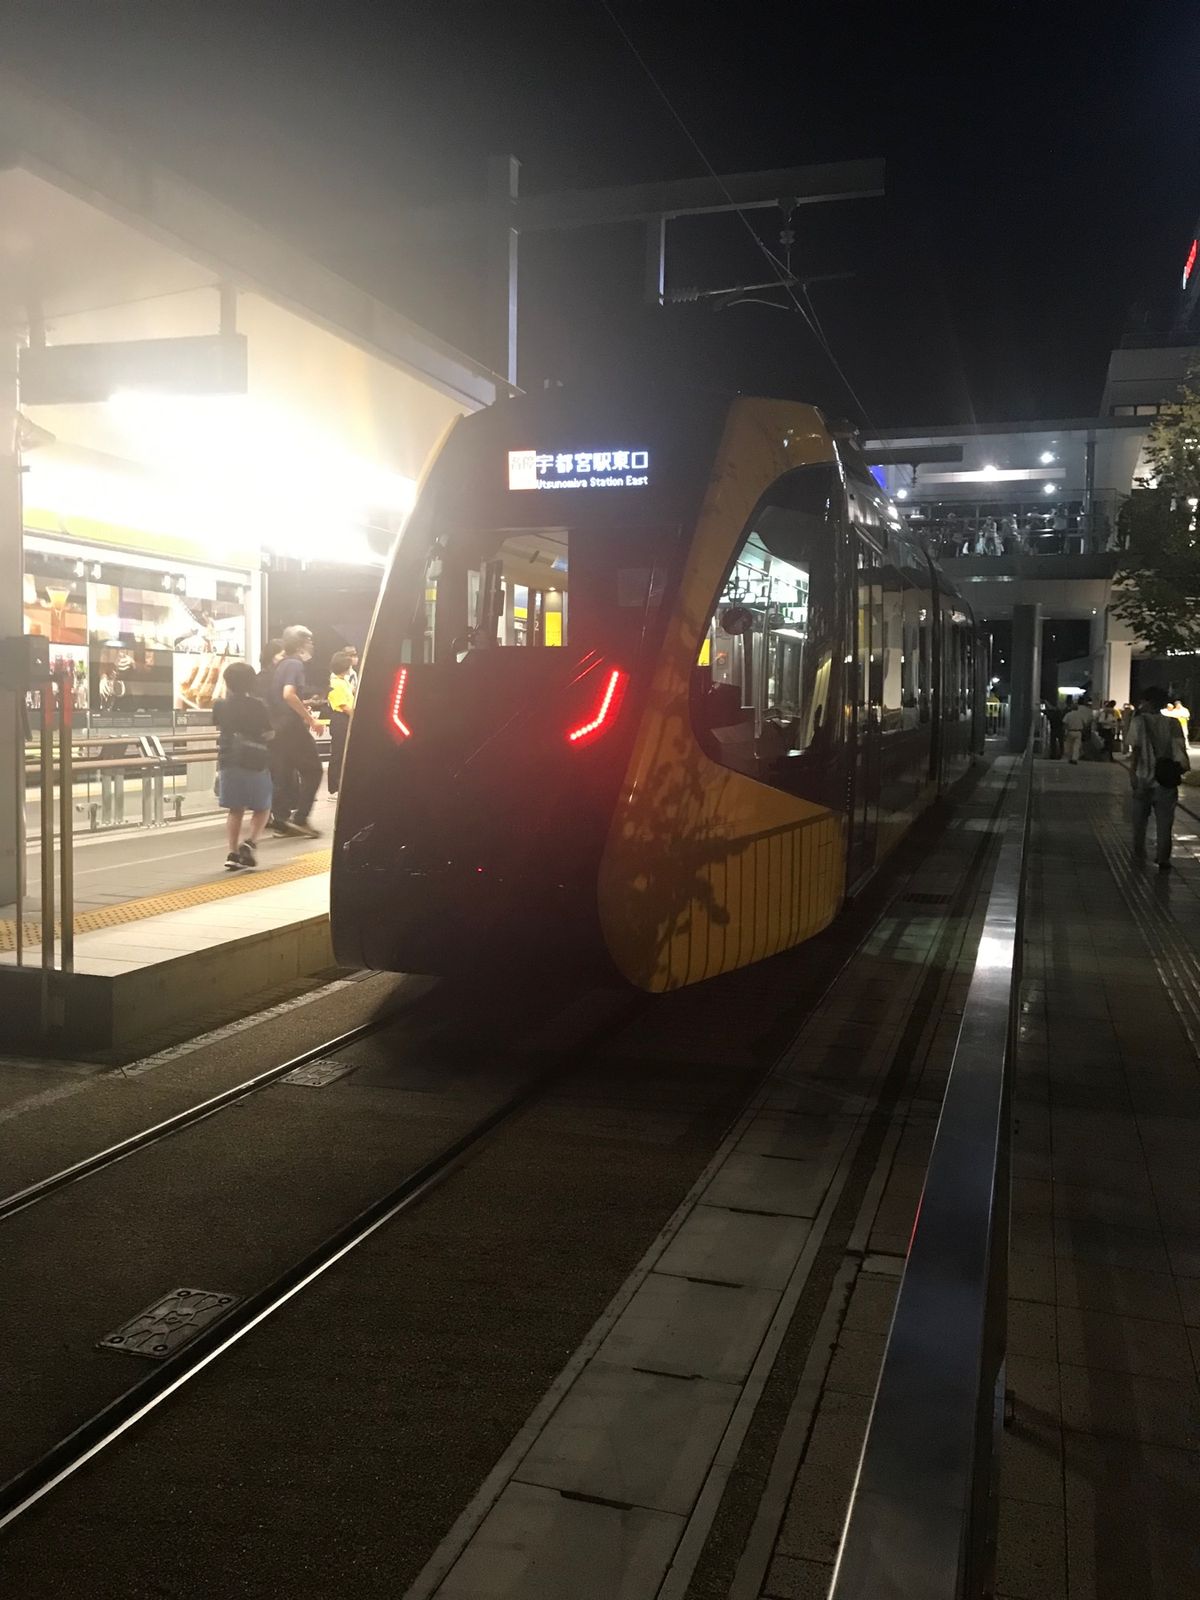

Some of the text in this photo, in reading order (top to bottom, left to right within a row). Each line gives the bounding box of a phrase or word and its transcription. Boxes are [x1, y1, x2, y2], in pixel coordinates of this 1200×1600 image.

[536, 450, 649, 475] 宇都宮駅東口
[536, 475, 649, 490] Utsunomiya Station East
